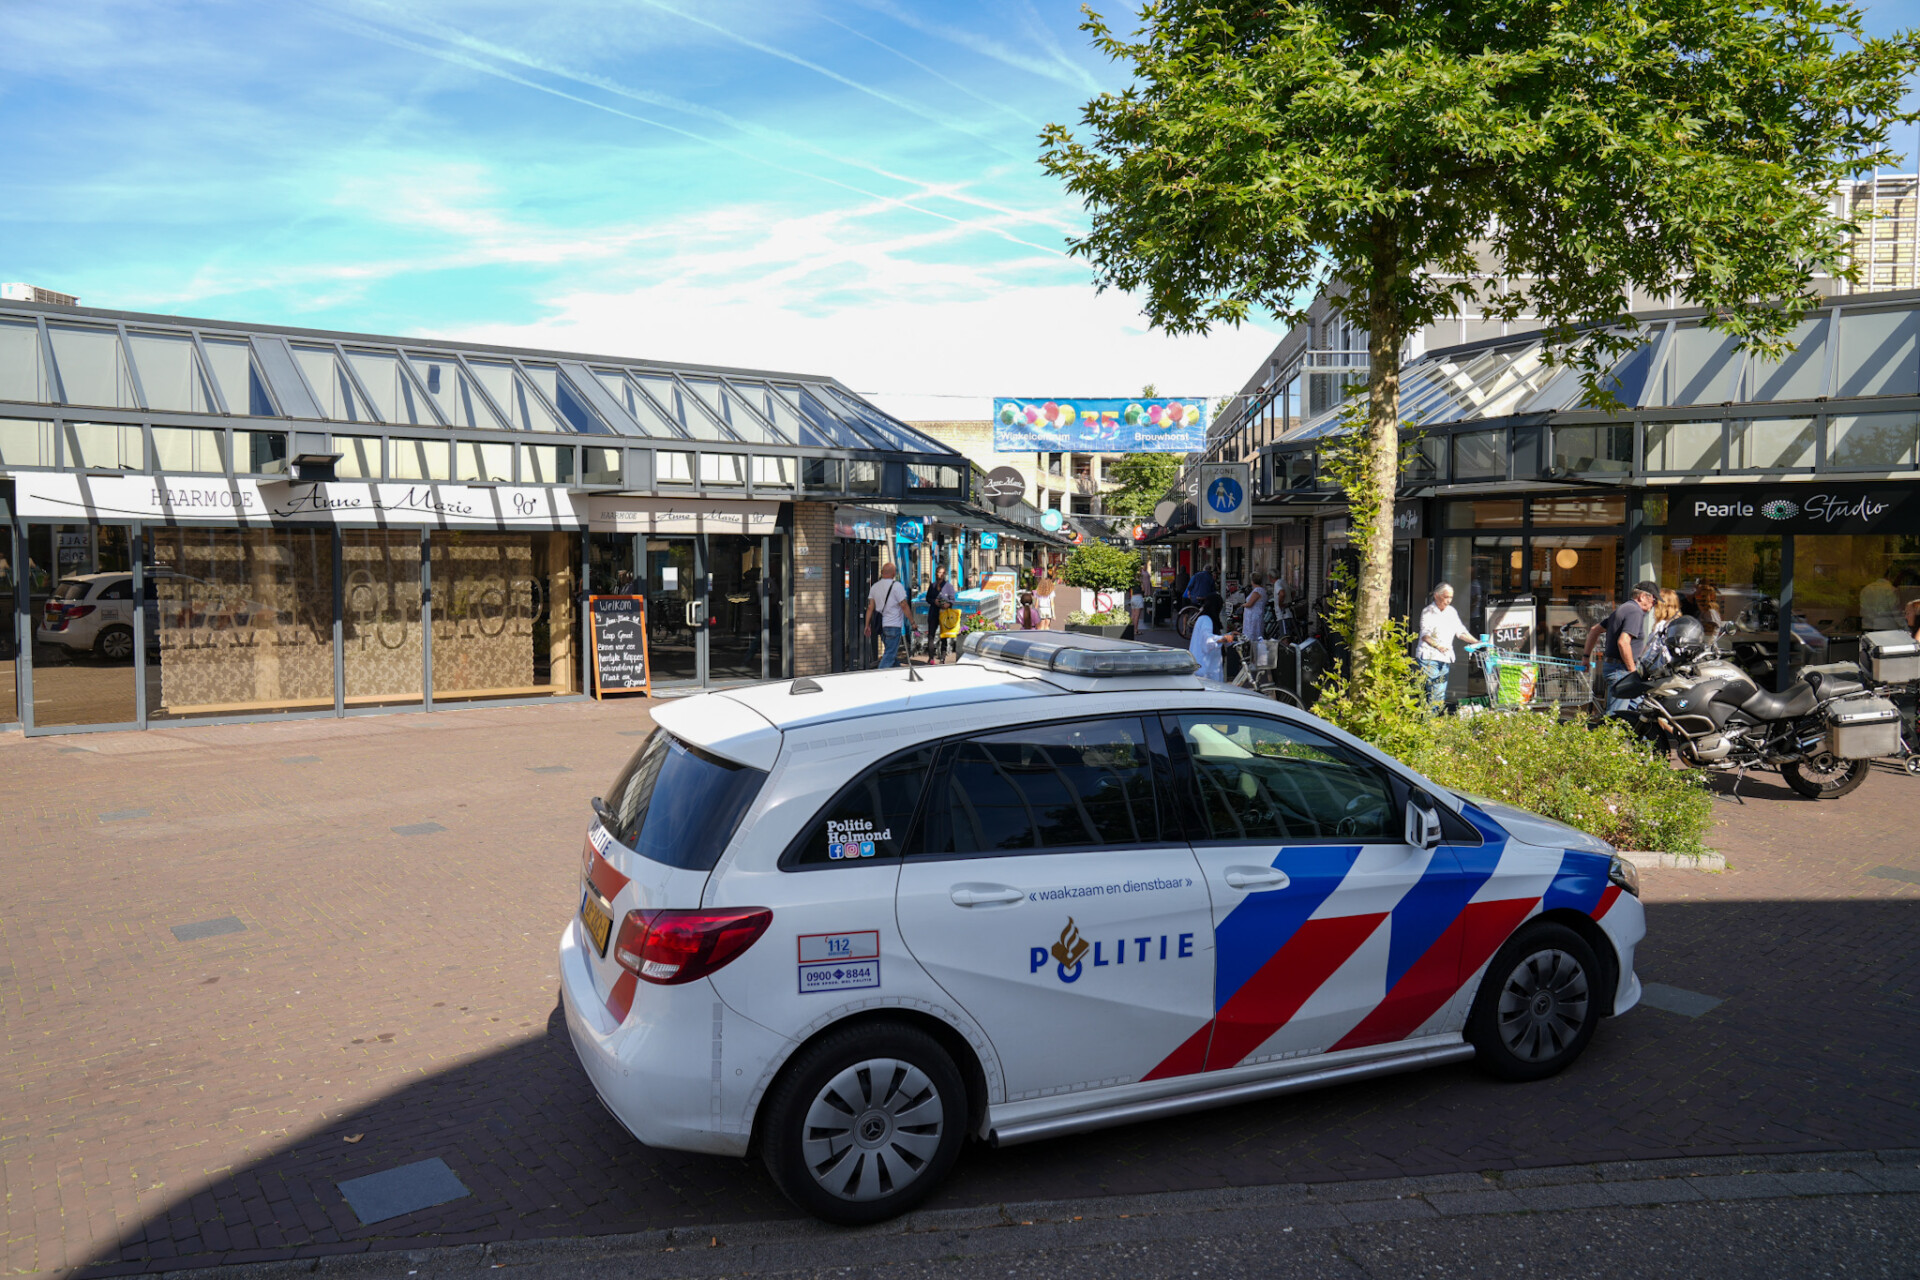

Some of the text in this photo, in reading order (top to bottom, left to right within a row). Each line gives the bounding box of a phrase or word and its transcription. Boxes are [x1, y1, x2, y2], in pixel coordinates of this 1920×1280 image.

[1079, 411, 1120, 441] 35
[1134, 432, 1190, 442] Brouwhorst
[1214, 467, 1235, 475] ZONE
[151, 489, 253, 508] HAARMODE
[274, 482, 361, 517] Anne
[376, 486, 472, 514] Marie
[1694, 494, 1889, 523] Pearle Studio
[1497, 627, 1523, 643] SALE
[827, 819, 873, 832] Politie
[828, 829, 892, 843] Helmond
[1039, 886, 1104, 901] waakzaam
[1106, 884, 1121, 895] en
[1123, 877, 1183, 893] dienstbaar
[1030, 932, 1194, 984] POLITIE
[807, 967, 871, 982] 0900 8844
